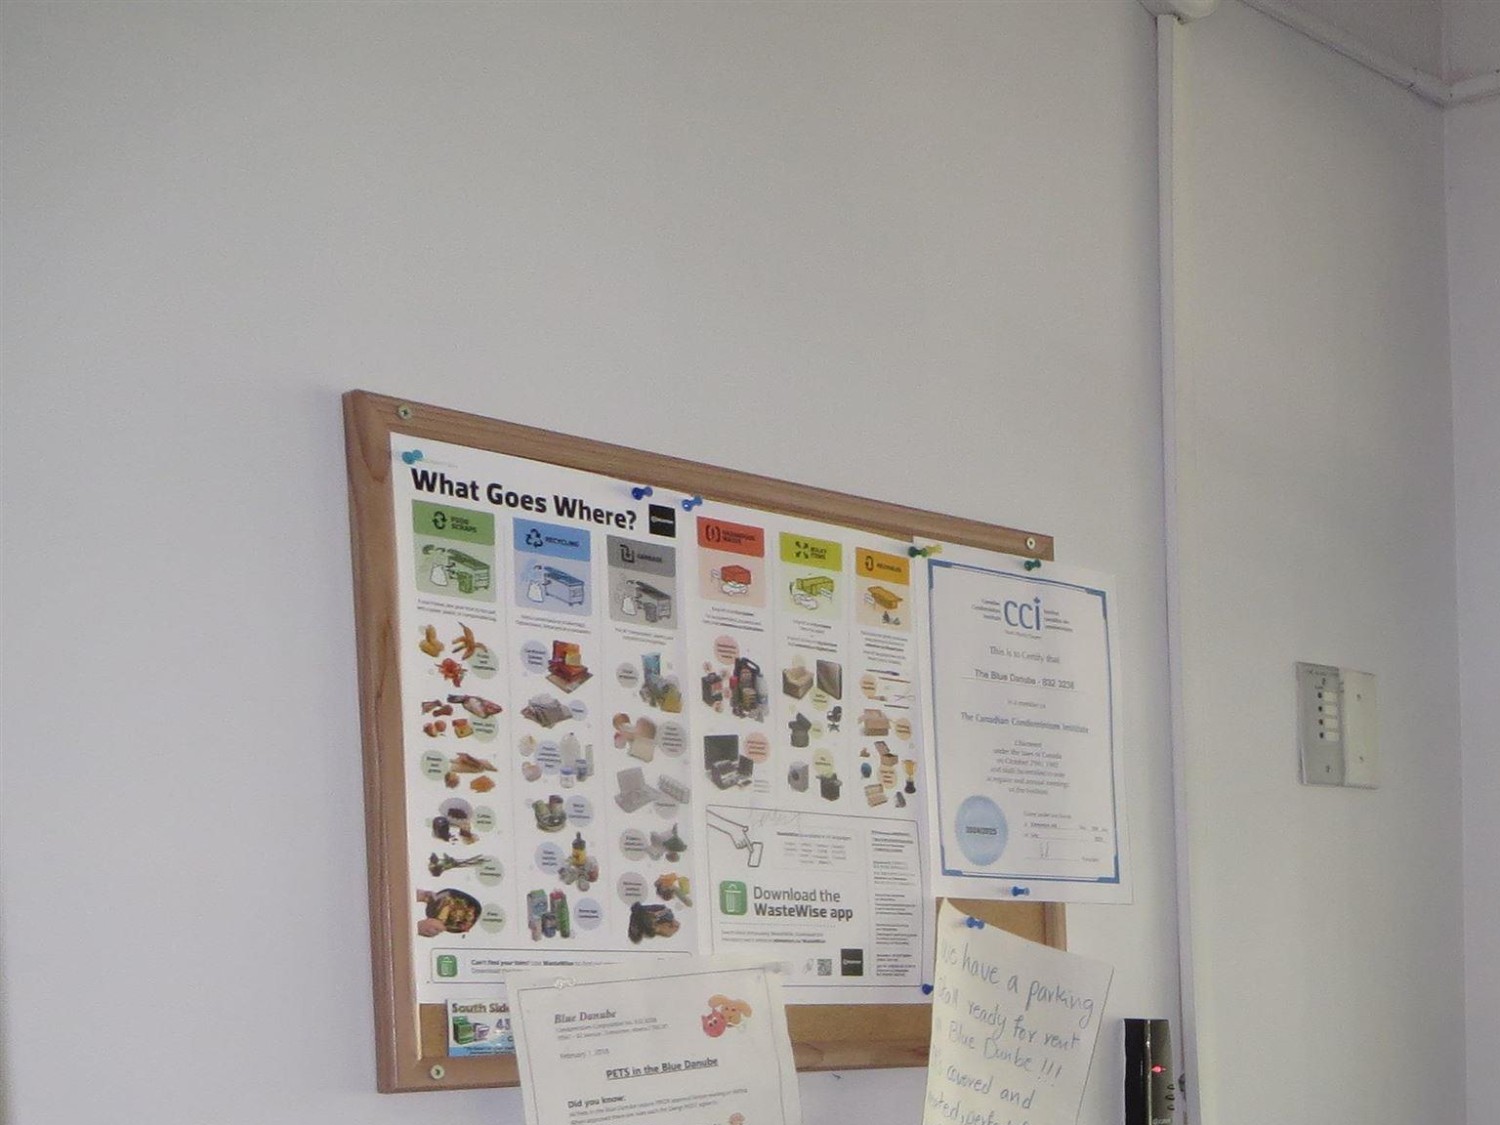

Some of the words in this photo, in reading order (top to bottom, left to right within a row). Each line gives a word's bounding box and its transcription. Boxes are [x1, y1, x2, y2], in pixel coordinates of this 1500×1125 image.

[411, 468, 479, 501] What
[486, 483, 547, 513] Goes
[554, 495, 637, 531] Where?
[545, 537, 580, 548] RECYCLING
[1003, 597, 1041, 630] cci
[975, 669, 989, 679] The
[991, 671, 1008, 681] Blue
[1010, 674, 1036, 685] Danube
[961, 711, 974, 721] The
[754, 886, 816, 902] Download
[820, 888, 841, 903] the
[754, 902, 827, 919] WasteWise
[830, 907, 853, 922] app
[962, 942, 1000, 984] have
[1007, 974, 1018, 993] a
[1025, 980, 1094, 1029] parking
[555, 1013, 577, 1024] Blue
[580, 1009, 617, 1021] Danube
[969, 1000, 1007, 1041] ready
[1013, 1015, 1037, 1043] for
[1044, 1031, 1080, 1051] rent
[606, 1068, 630, 1080] PETS
[632, 1066, 641, 1076] in
[644, 1064, 660, 1075] the
[661, 1061, 682, 1073] Blue
[684, 1057, 719, 1071] Danube
[567, 1099, 582, 1109] Did
[584, 1098, 599, 1108] you
[1000, 1088, 1035, 1109] and
